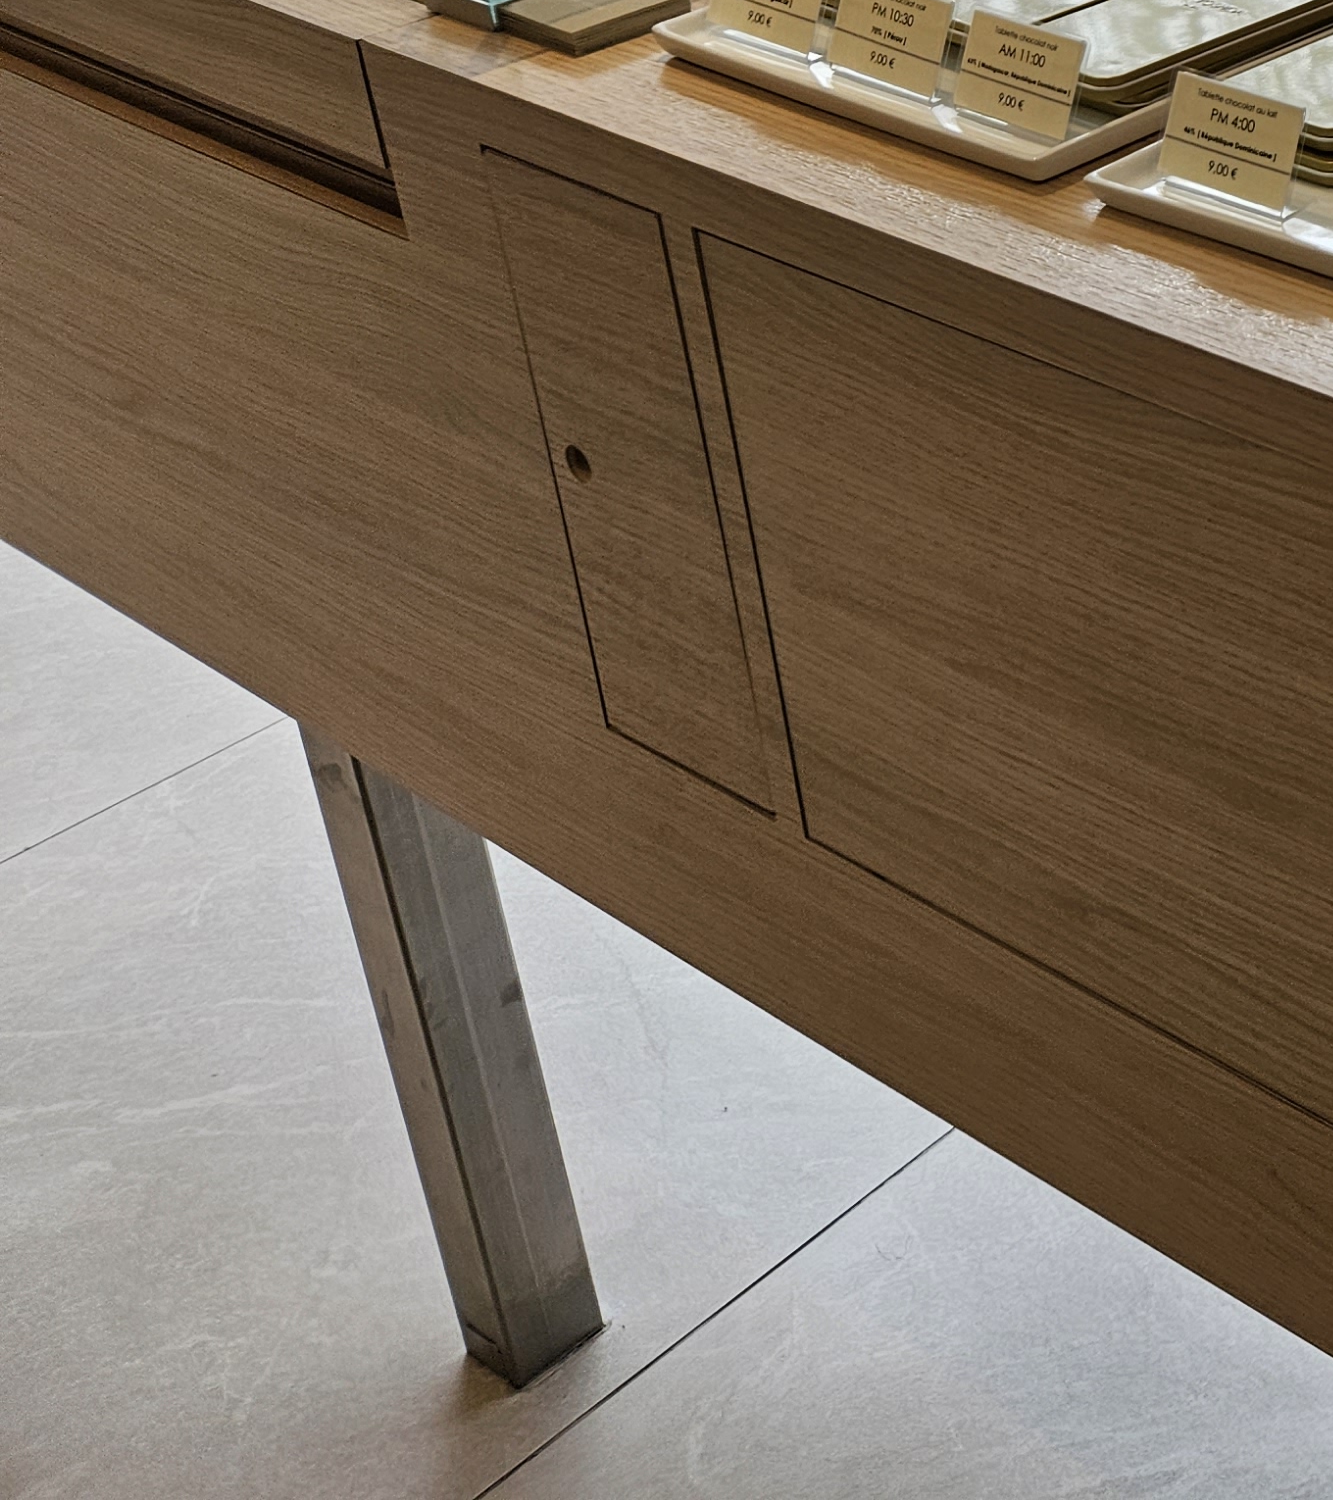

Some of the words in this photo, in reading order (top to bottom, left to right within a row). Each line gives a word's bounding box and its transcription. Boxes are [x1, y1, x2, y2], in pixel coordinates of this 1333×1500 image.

[871, 2, 888, 18] PM
[889, 7, 915, 28] 10:30
[998, 43, 1017, 60] AM
[1019, 49, 1046, 68] 11:00
[1210, 108, 1229, 126] PM
[1231, 115, 1256, 133] 4:00
